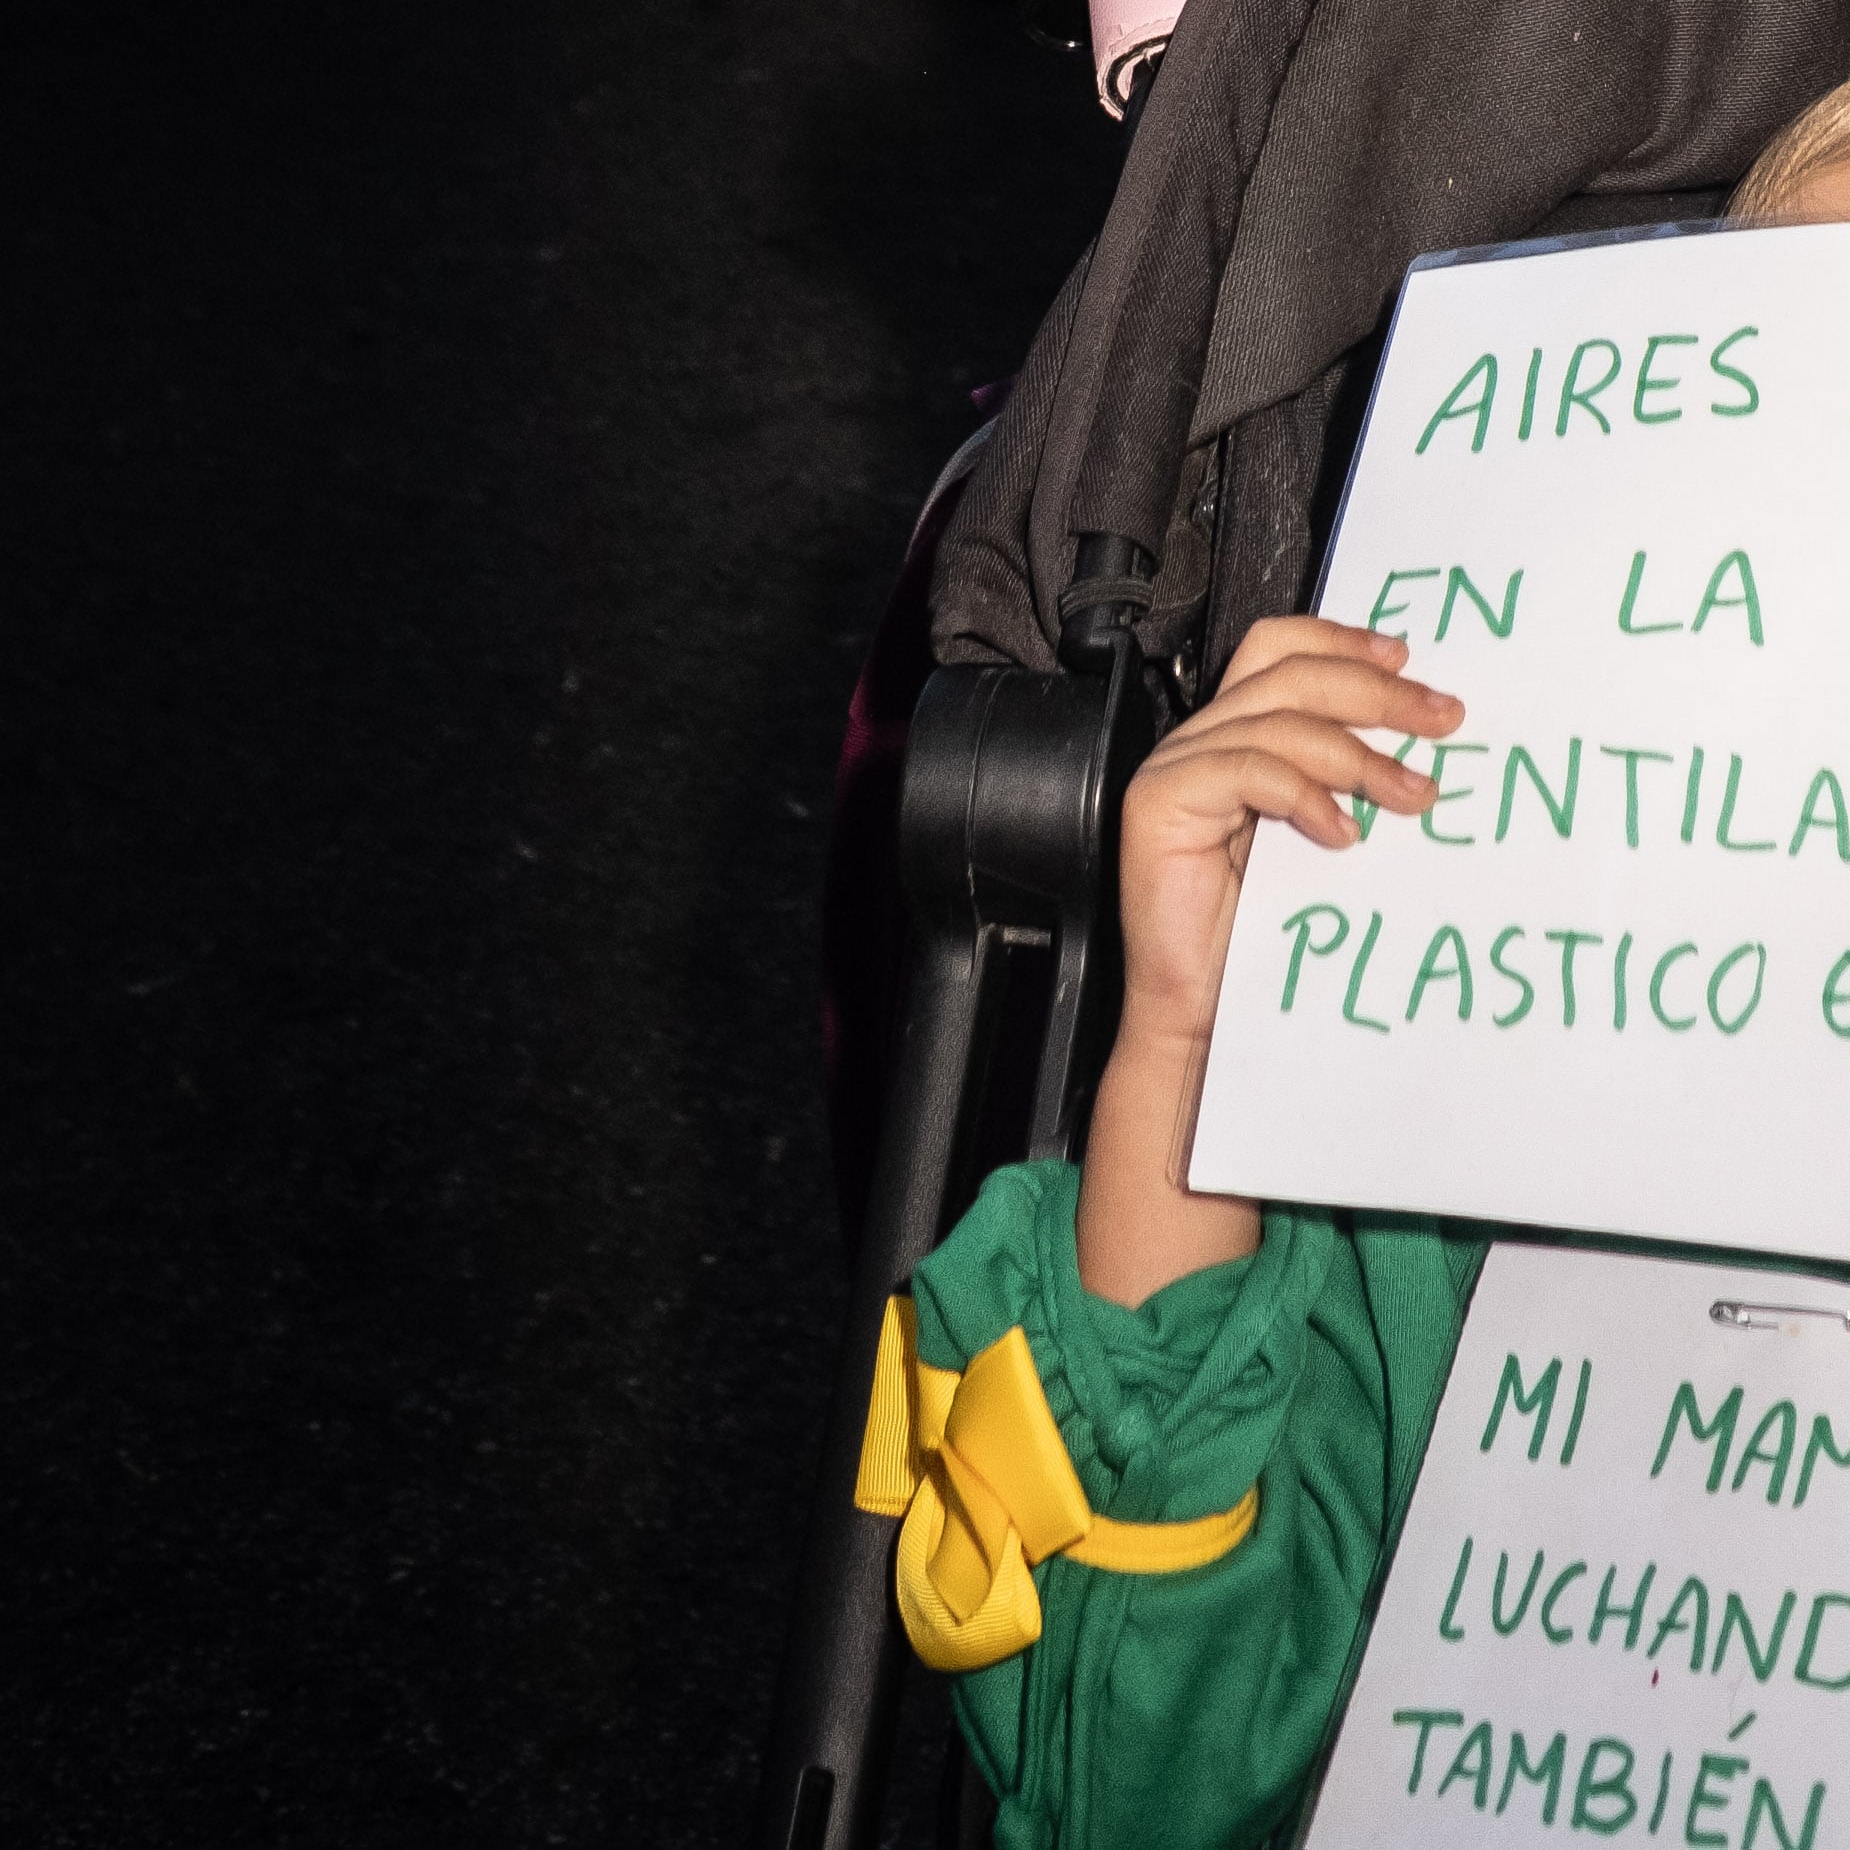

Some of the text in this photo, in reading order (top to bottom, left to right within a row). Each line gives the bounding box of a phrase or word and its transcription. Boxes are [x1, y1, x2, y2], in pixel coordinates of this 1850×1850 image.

[1415, 325, 1761, 456] AIRES
[1367, 565, 1525, 644] EN
[1617, 549, 1765, 647] LA
[1279, 903, 1767, 1036] PLASTICO
[1479, 1352, 1592, 1466] MI
[1392, 1709, 1826, 1850] TAMBIÉN
